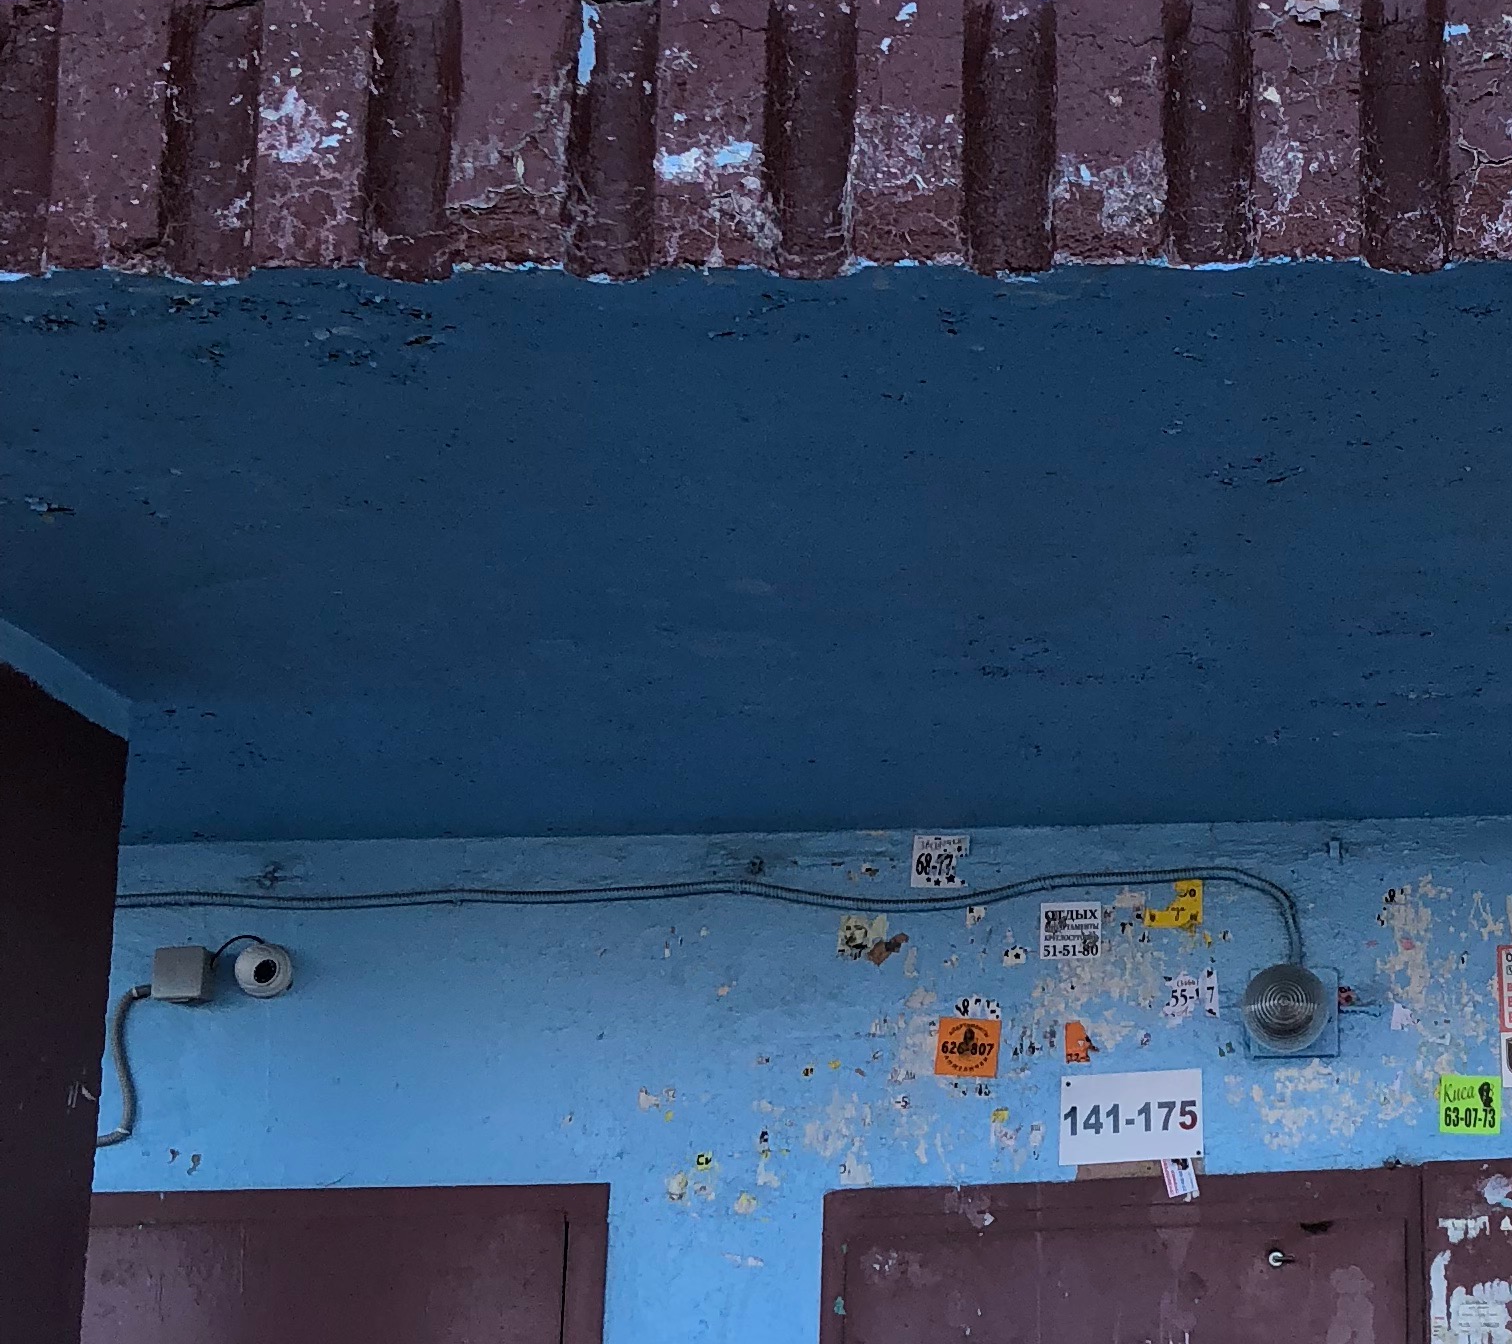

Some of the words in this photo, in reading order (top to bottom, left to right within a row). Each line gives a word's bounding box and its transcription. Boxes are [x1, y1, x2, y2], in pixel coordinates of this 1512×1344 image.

[1044, 909, 1098, 922] ОТДЫХ
[1043, 944, 1099, 957] 51-51-80
[941, 1040, 995, 1057] 626-807
[1063, 1099, 1198, 1136] 141-175
[1444, 1106, 1496, 1129] 63-07-73
